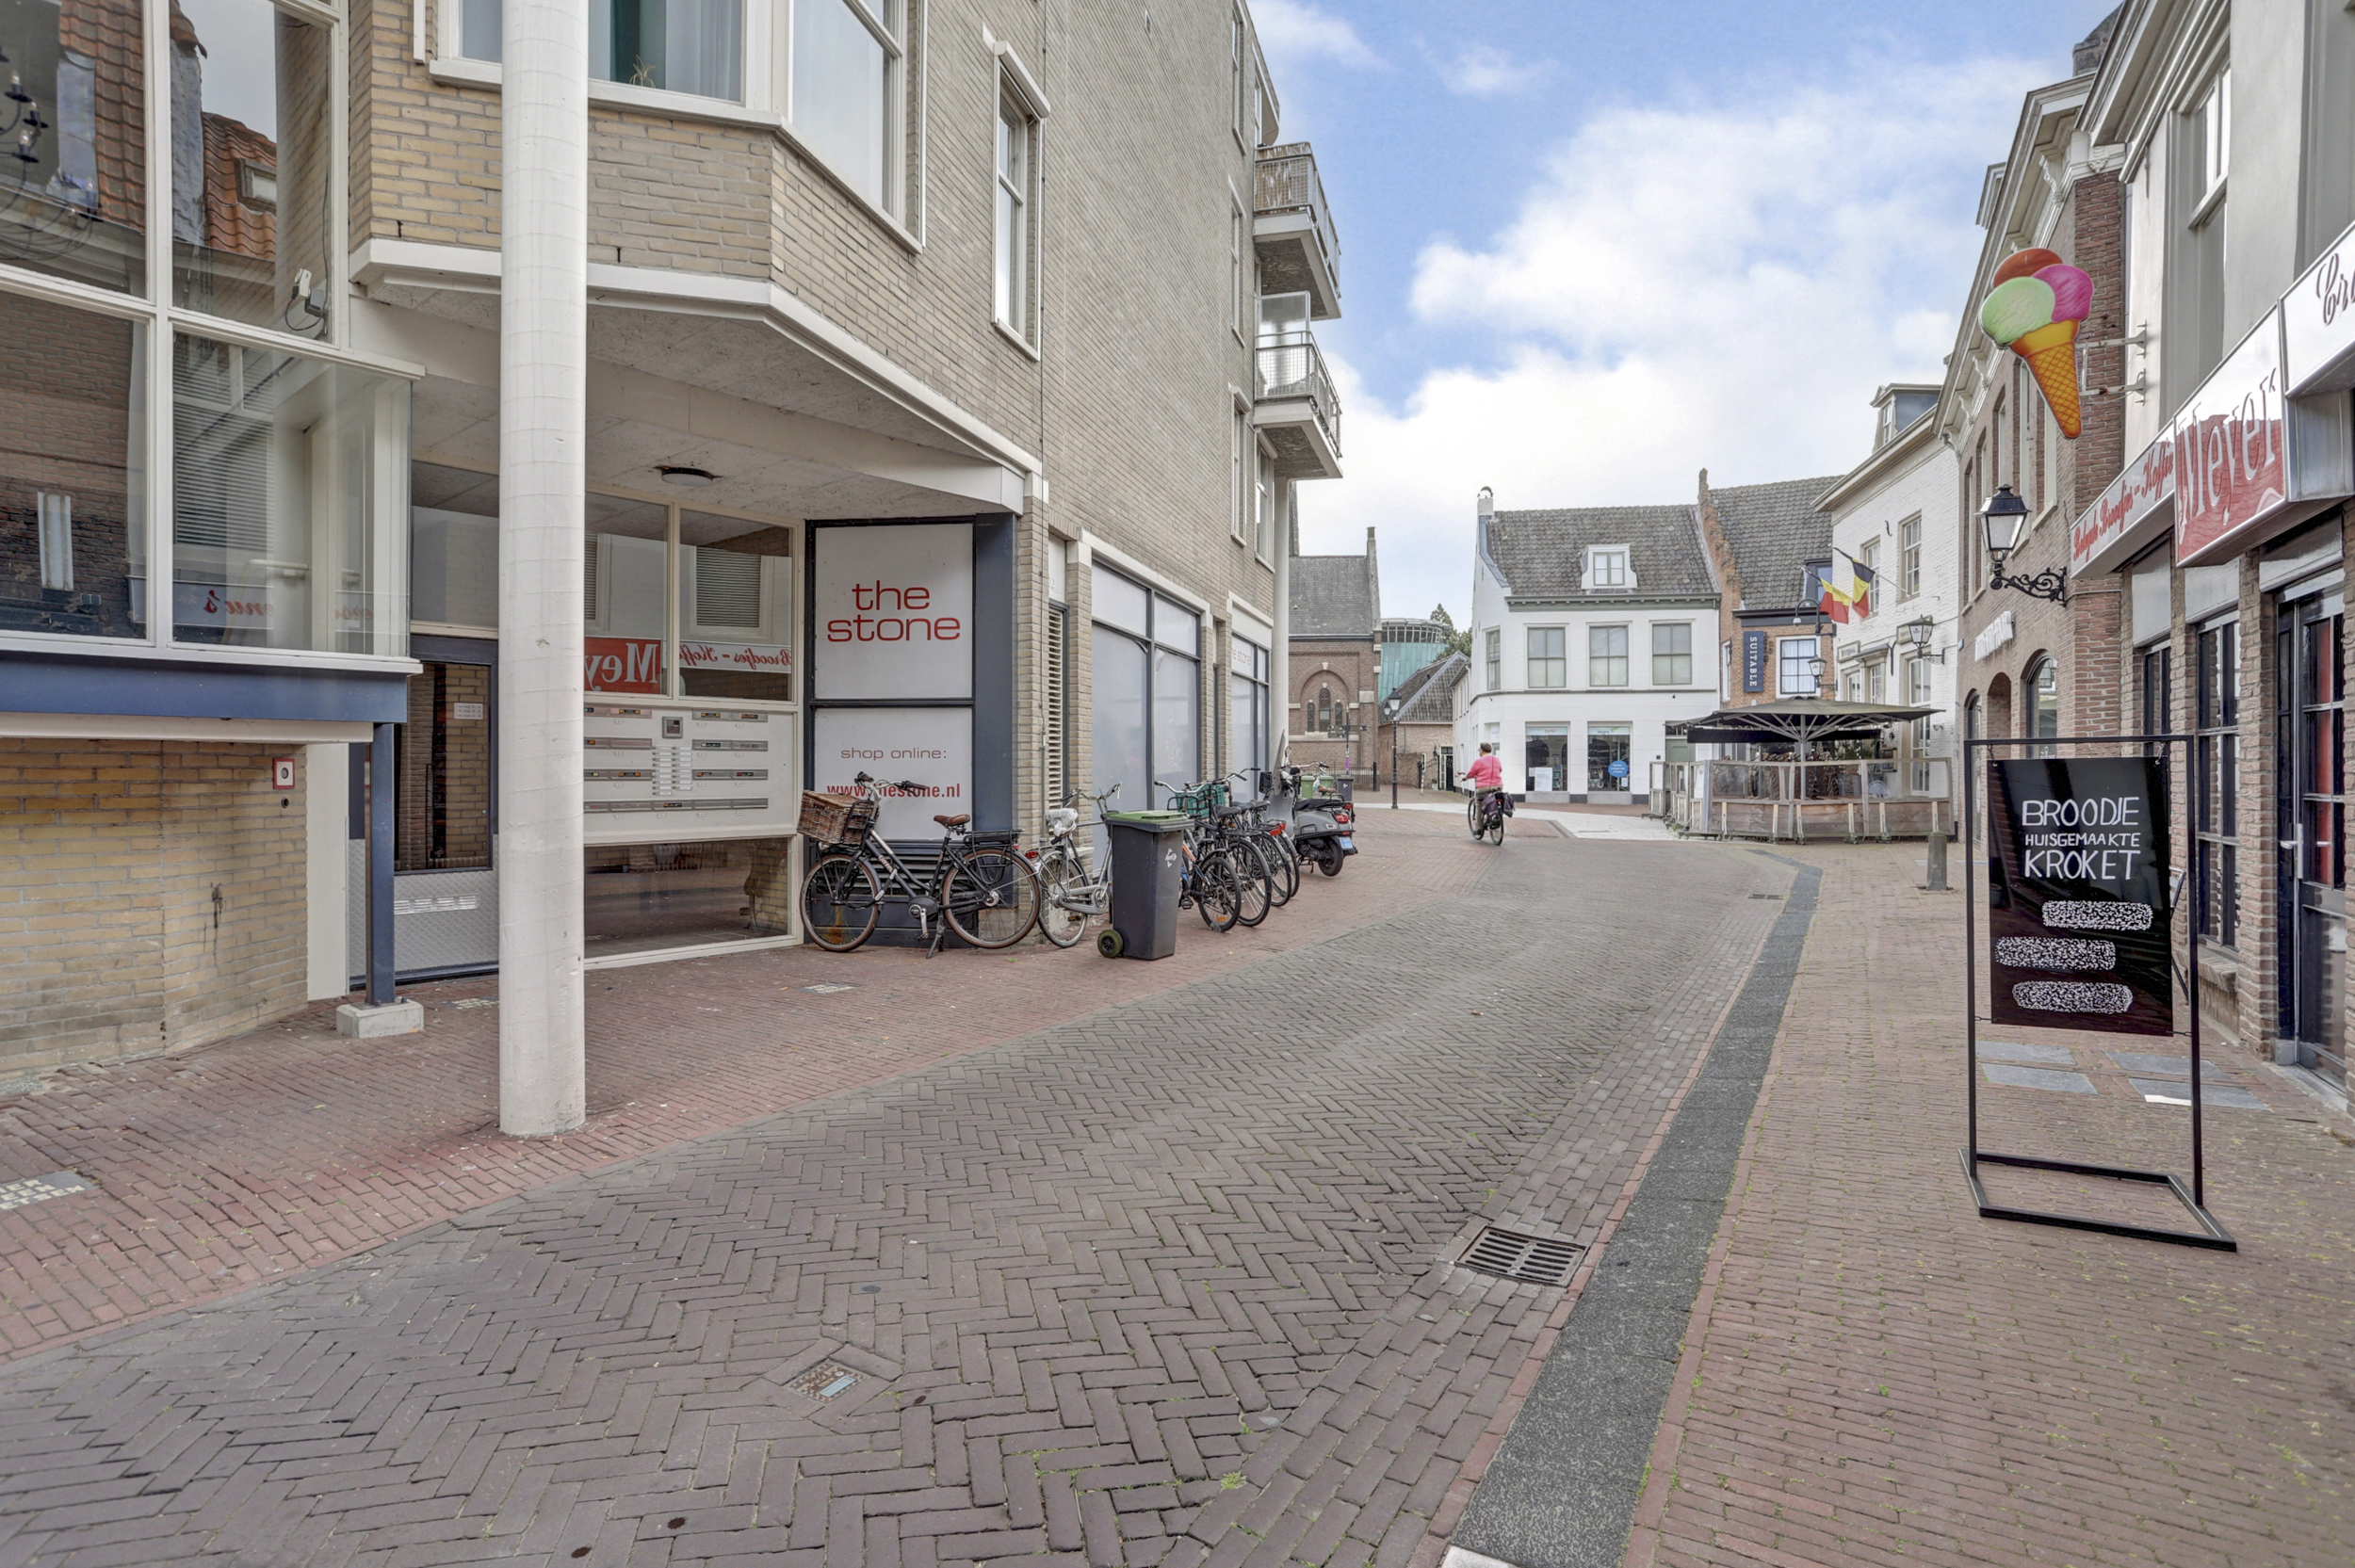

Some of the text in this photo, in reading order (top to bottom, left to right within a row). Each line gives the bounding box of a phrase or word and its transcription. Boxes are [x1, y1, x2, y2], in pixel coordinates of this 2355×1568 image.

[2177, 367, 2277, 527] Meyer
[2099, 479, 2134, 536] Broodjes
[852, 580, 930, 610] the
[827, 614, 961, 642] stone
[1749, 636, 1758, 687] SUITABLE
[840, 748, 947, 760] shop online:
[2022, 797, 2140, 827] BROODJE
[2024, 832, 2141, 848] HUISGEMAAKTE
[2024, 849, 2141, 881] KROKET
[0, 1184, 57, 1202] EEN
